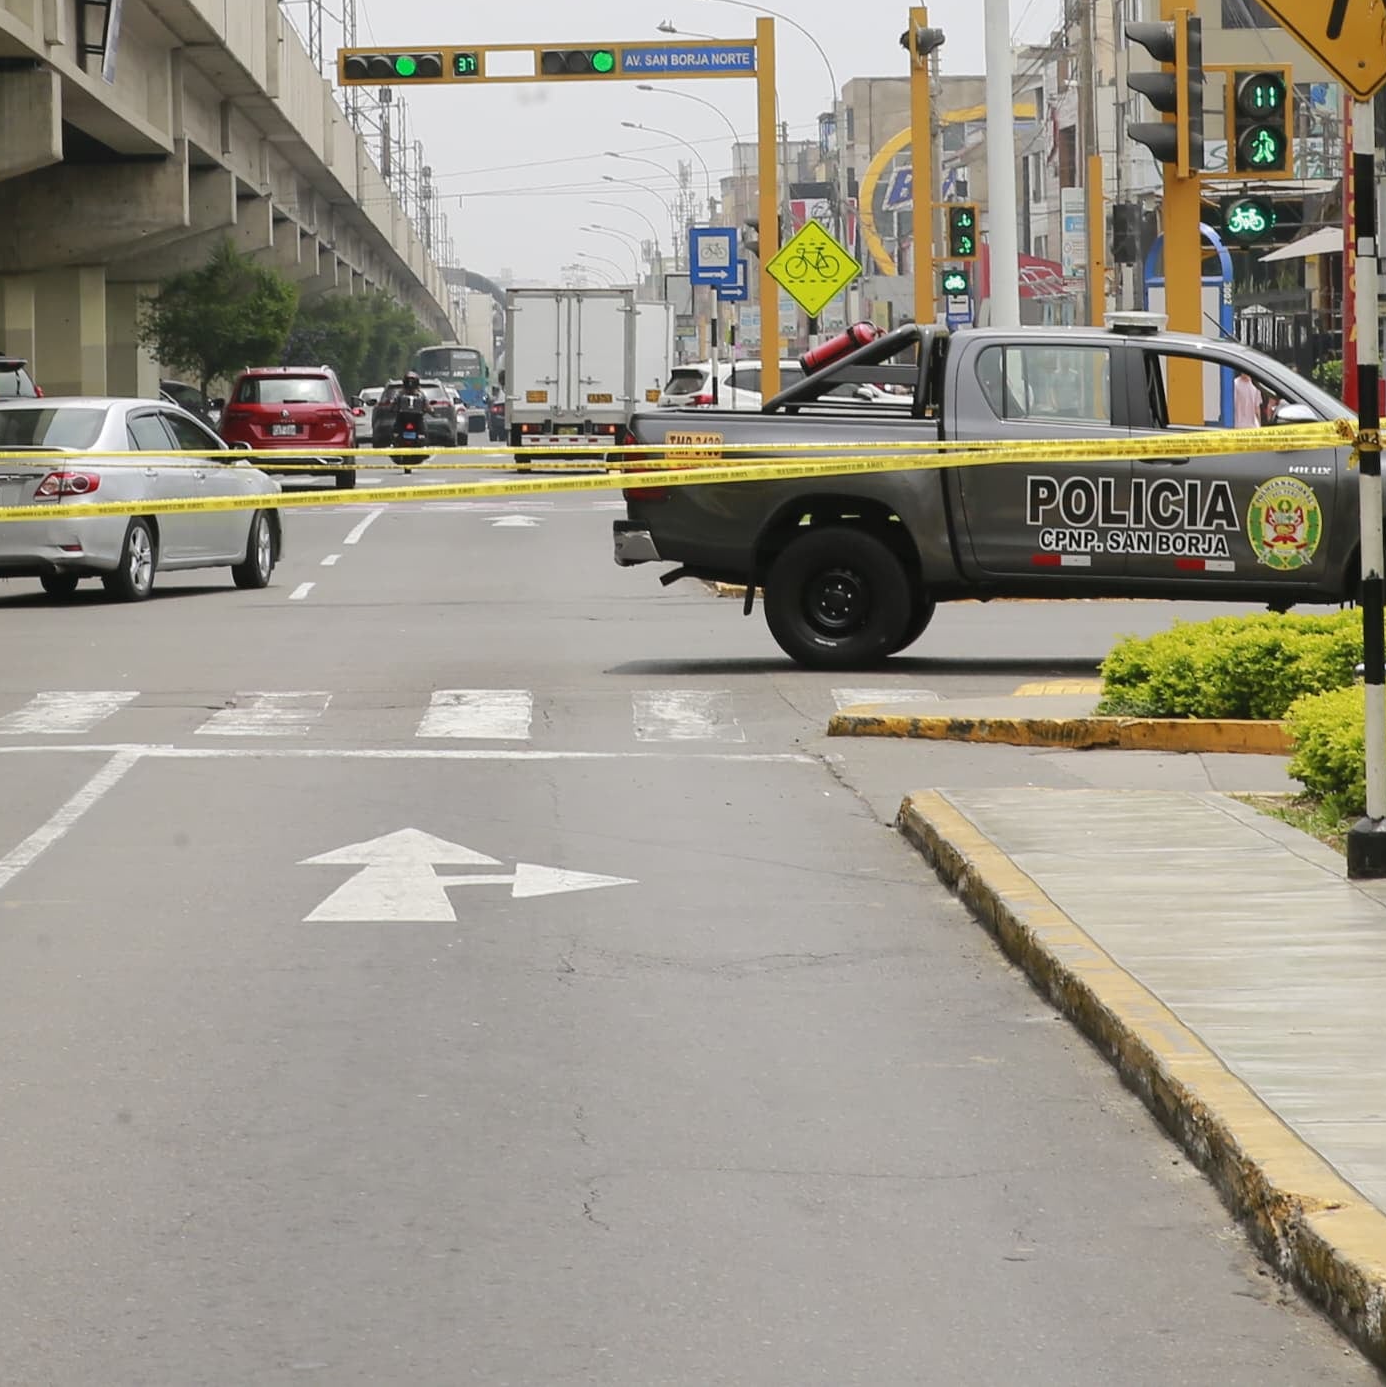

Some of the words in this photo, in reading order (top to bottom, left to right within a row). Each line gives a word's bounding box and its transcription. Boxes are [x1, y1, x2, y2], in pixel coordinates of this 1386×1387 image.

[459, 57, 474, 71] 37
[625, 54, 642, 66] AV.
[645, 54, 668, 66] SAN
[671, 53, 710, 65] BORJA
[712, 53, 750, 64] NORTE
[1289, 465, 1332, 475] HILUX
[1026, 475, 1241, 532] POLICIA
[1039, 527, 1104, 552] CPNP.
[1107, 530, 1153, 554] SAN
[1156, 532, 1231, 557] BORJA
